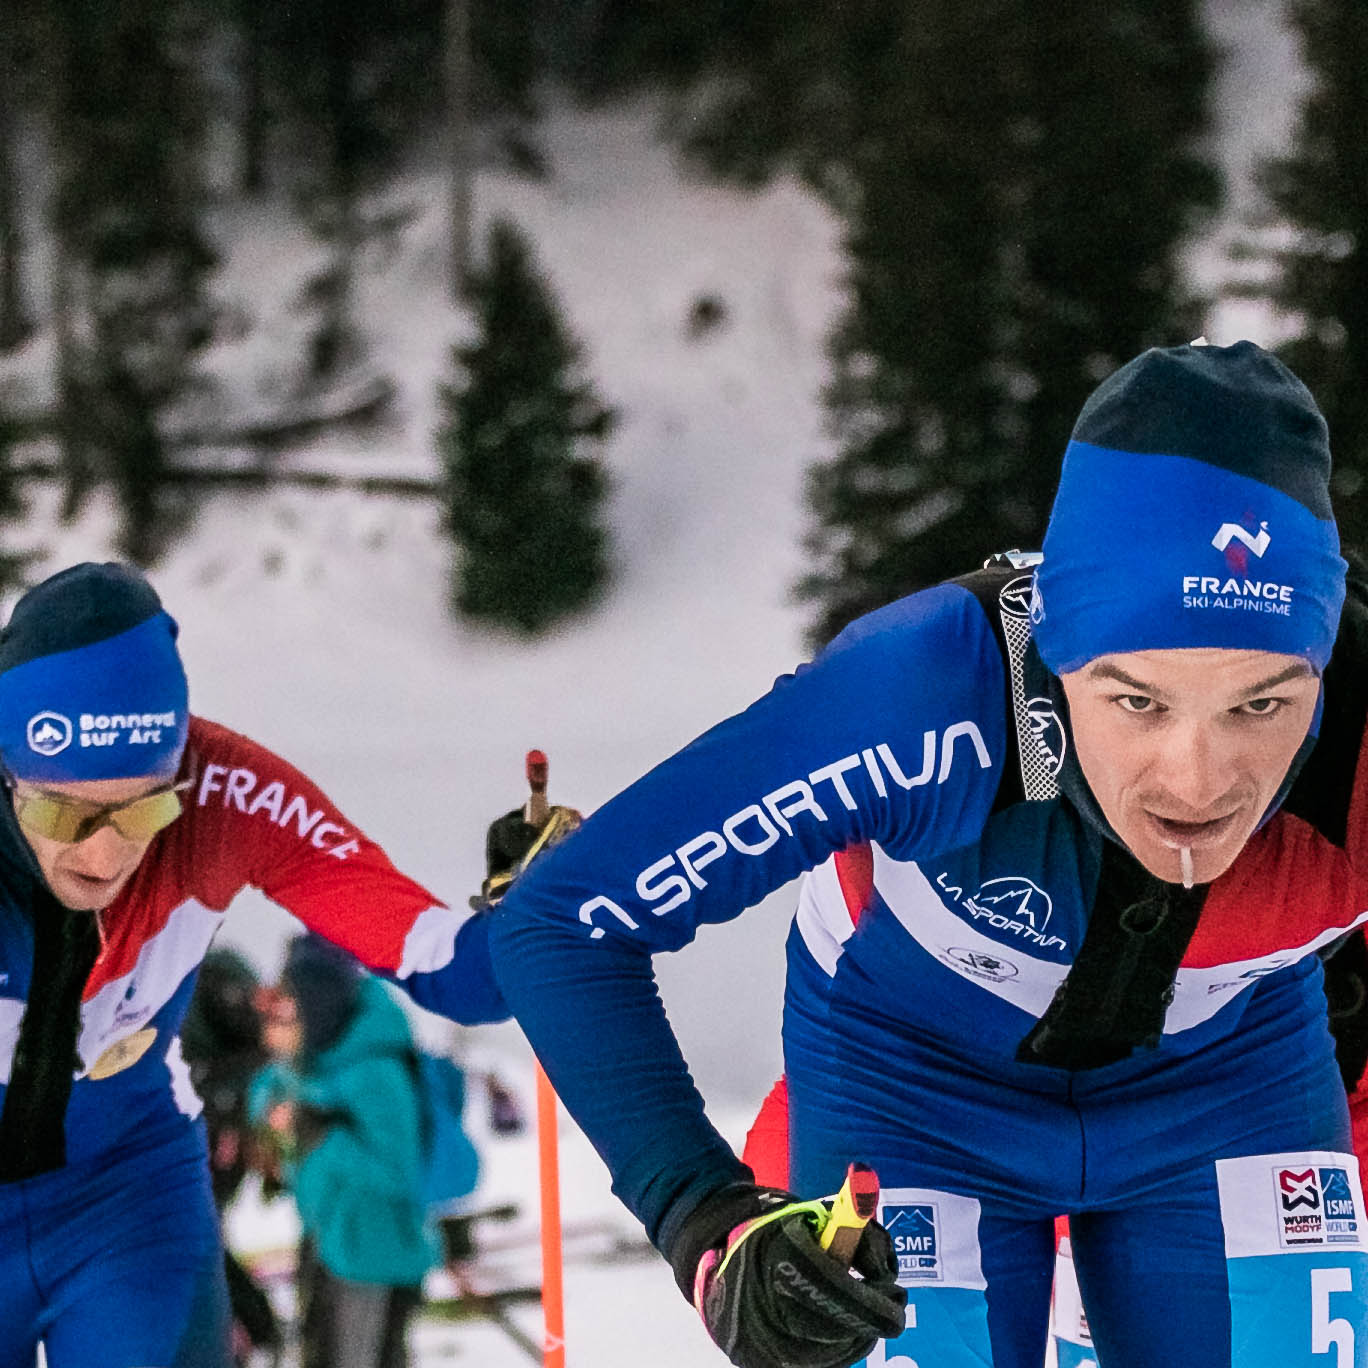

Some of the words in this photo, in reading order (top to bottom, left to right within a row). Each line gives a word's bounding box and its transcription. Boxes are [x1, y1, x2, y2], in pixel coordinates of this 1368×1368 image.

[1183, 576, 1294, 602] FRANCE
[1183, 595, 1292, 616] SKI-ALPINISME
[129, 728, 161, 744] Arc
[198, 763, 360, 861] FRANCE
[635, 720, 991, 917] SPORTIVA
[962, 897, 1068, 951] SPORTIVA
[1326, 1199, 1353, 1216] ISMF
[893, 1236, 933, 1252] SMF
